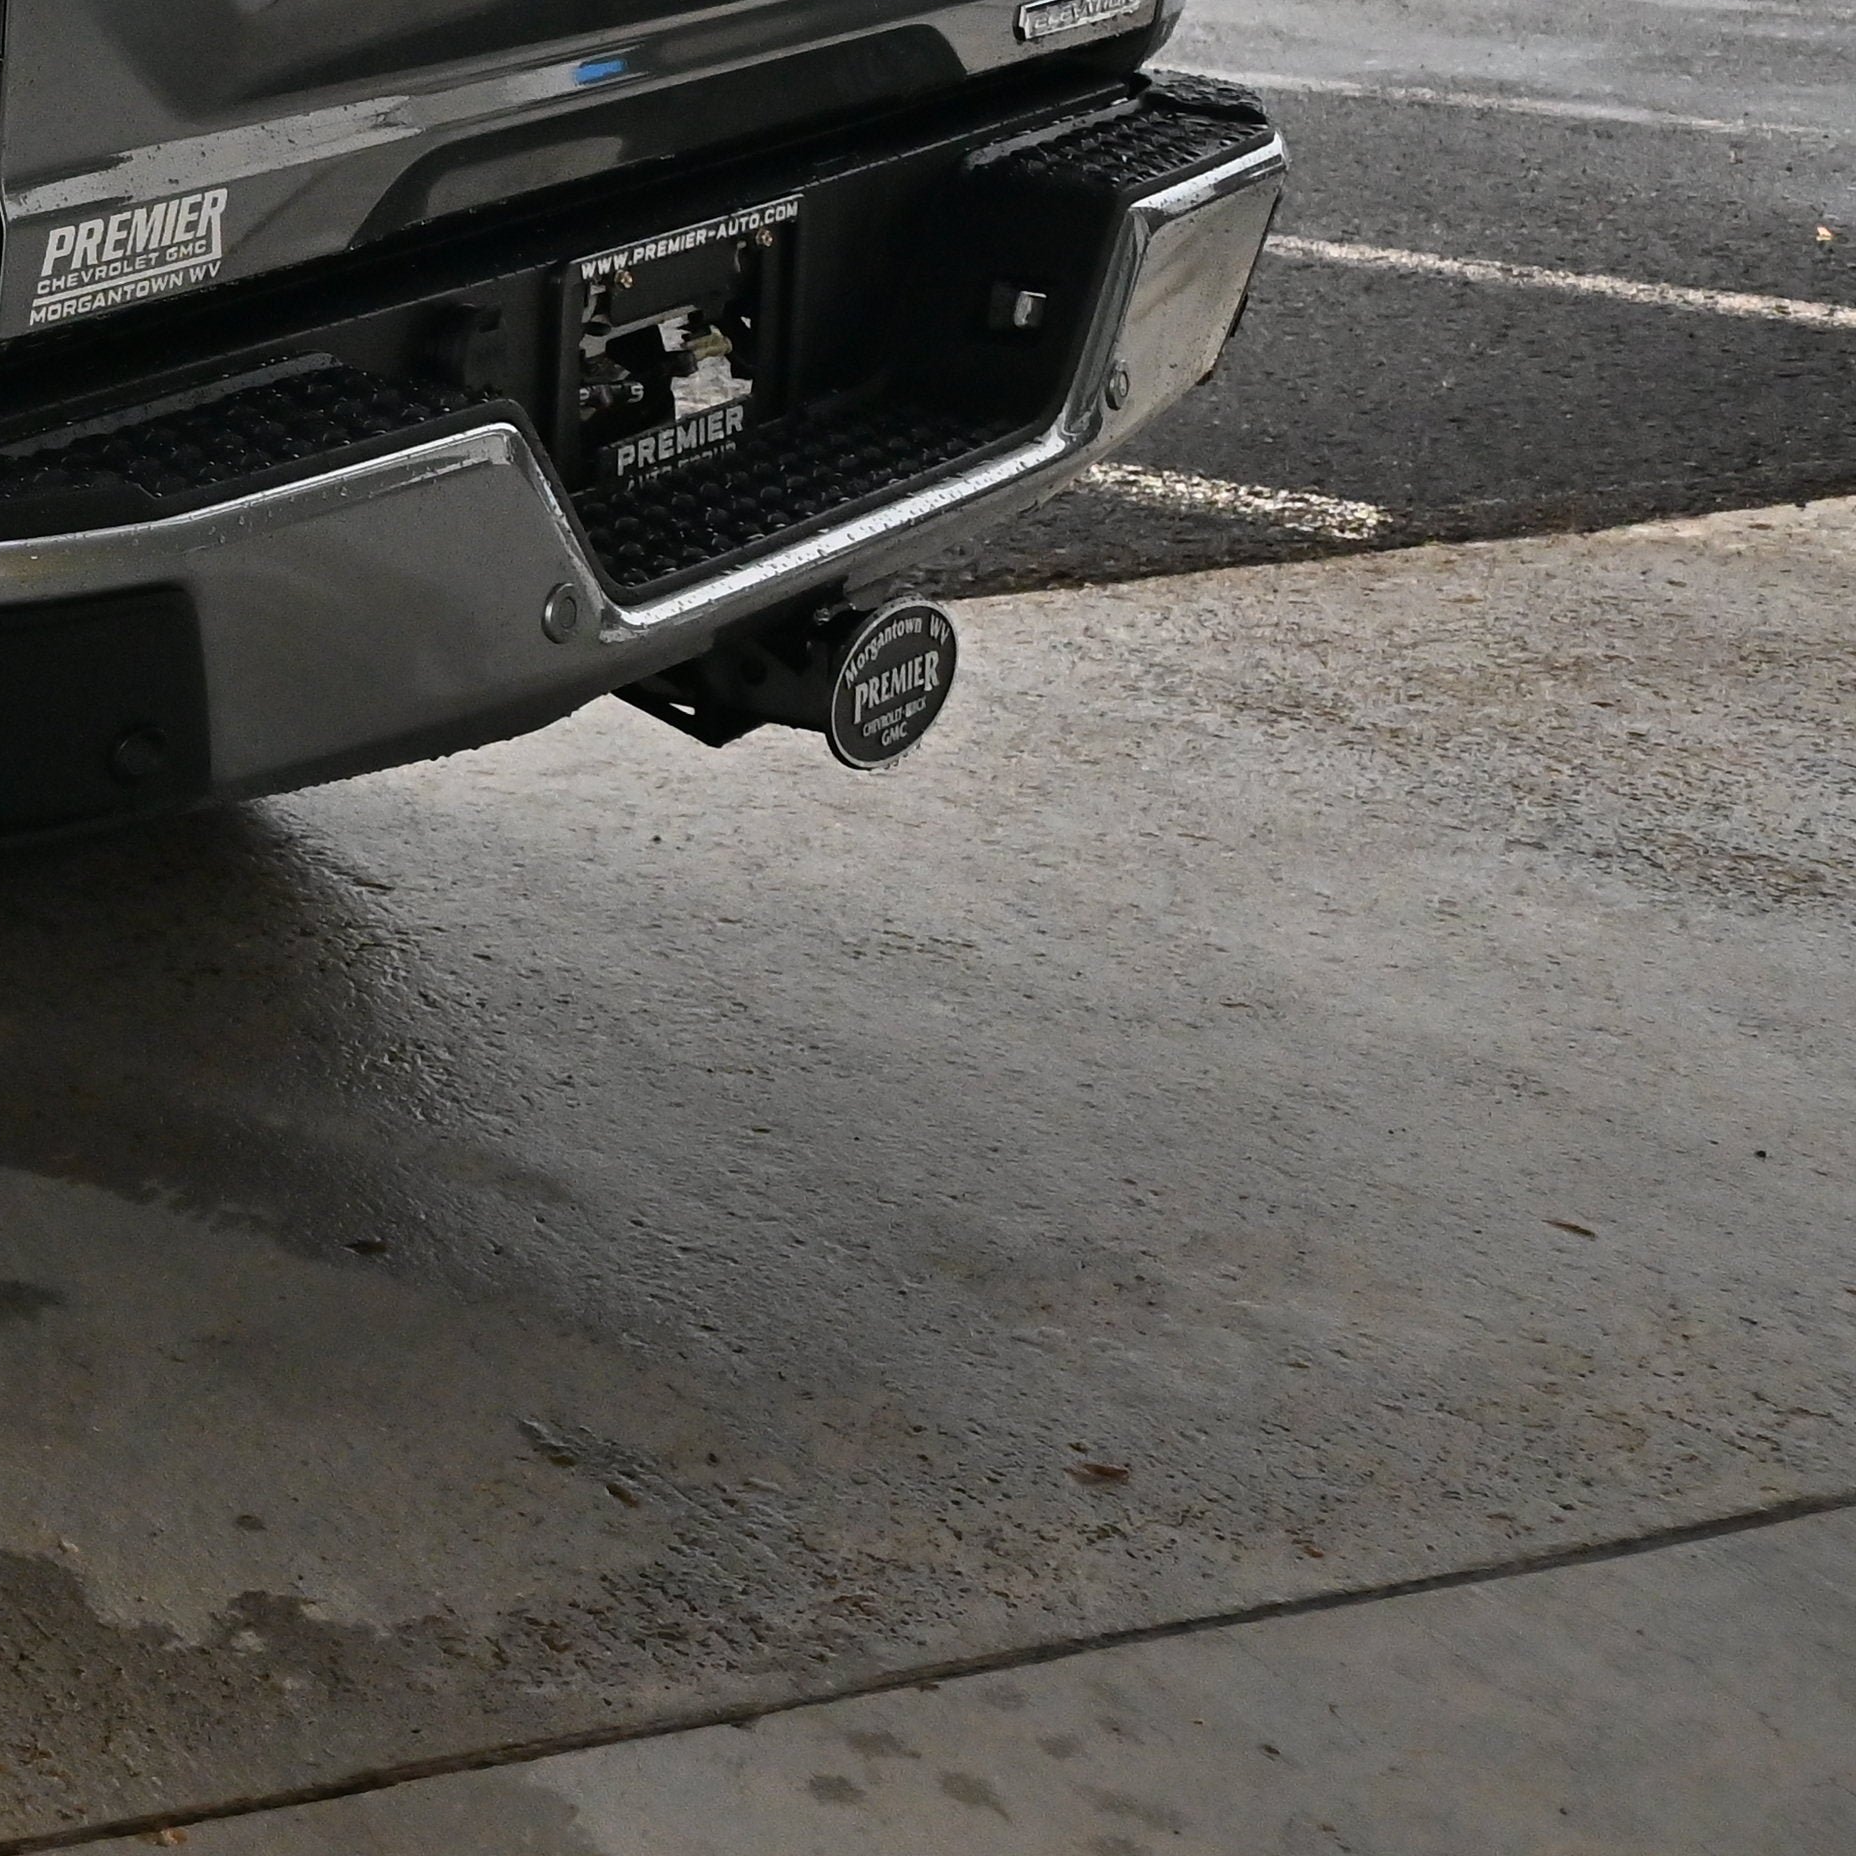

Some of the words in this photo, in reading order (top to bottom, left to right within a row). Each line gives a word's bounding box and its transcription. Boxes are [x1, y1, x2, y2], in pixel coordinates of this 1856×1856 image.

[38, 252, 160, 295] CHEVROLET
[165, 240, 207, 262] GMC
[40, 187, 228, 277] PREMIER
[581, 201, 799, 280] WWW.PREMIER-AUTO.COM
[29, 271, 184, 326] MORGANTOWN
[190, 260, 222, 284] WV
[617, 405, 744, 477] PREMIER
[844, 617, 923, 690] Morgantown
[929, 614, 951, 645] WV
[854, 650, 940, 725] PREMIER
[881, 720, 908, 747] GMC
